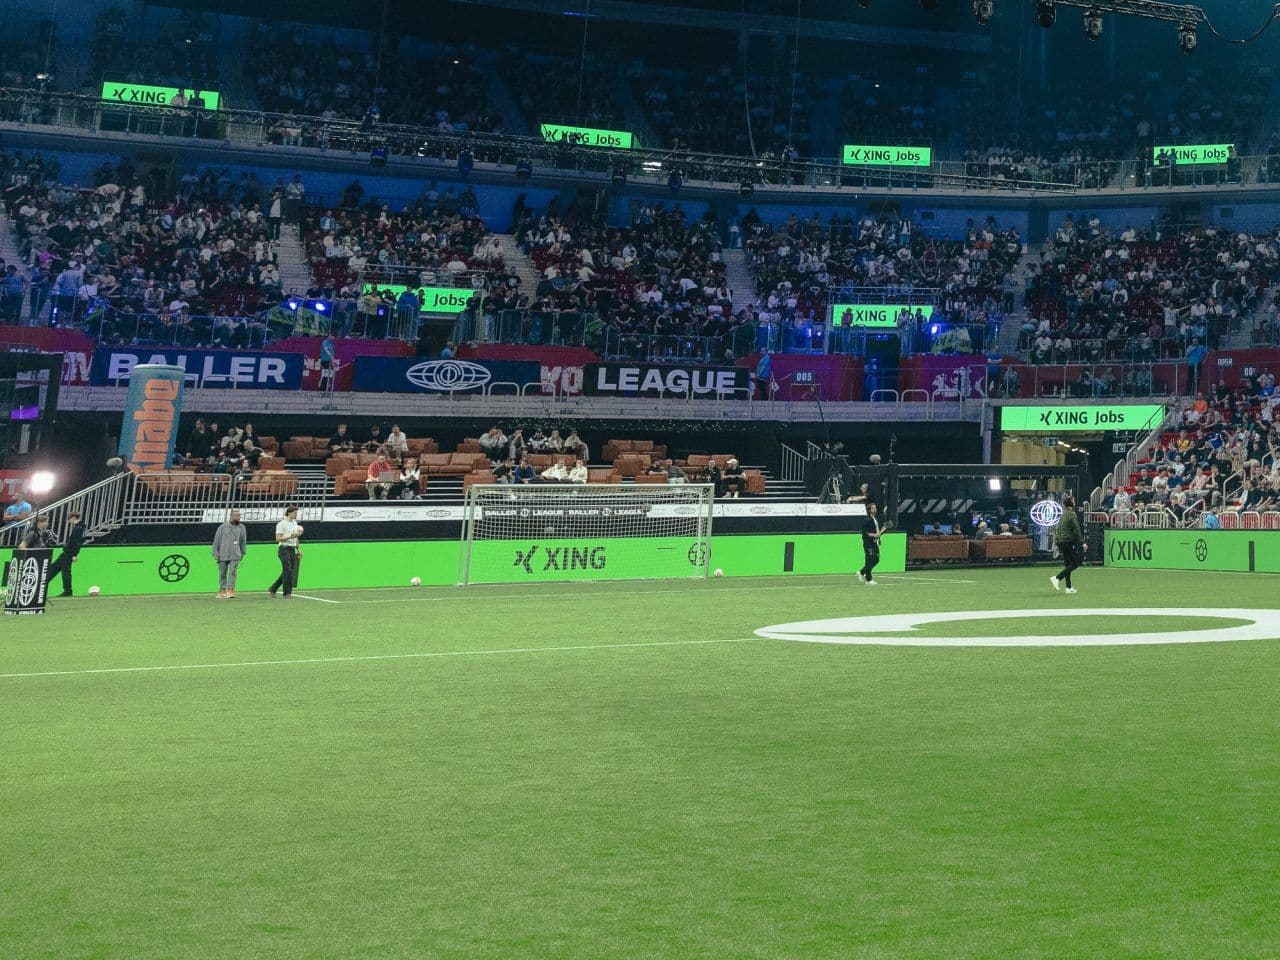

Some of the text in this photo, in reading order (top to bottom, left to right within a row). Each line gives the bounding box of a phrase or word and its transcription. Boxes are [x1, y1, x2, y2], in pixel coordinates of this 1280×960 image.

[130, 89, 166, 104] XING
[596, 134, 621, 147] Jobs
[863, 150, 920, 162] XING Jobs
[1203, 149, 1226, 160] Jobs
[433, 293, 466, 307] Jobs
[855, 310, 887, 322] XING
[597, 367, 736, 394] LEAGUE
[796, 371, 813, 382] 005
[1055, 410, 1124, 425] XING Jobs
[1117, 540, 1152, 561] XING
[543, 546, 607, 571] XING
